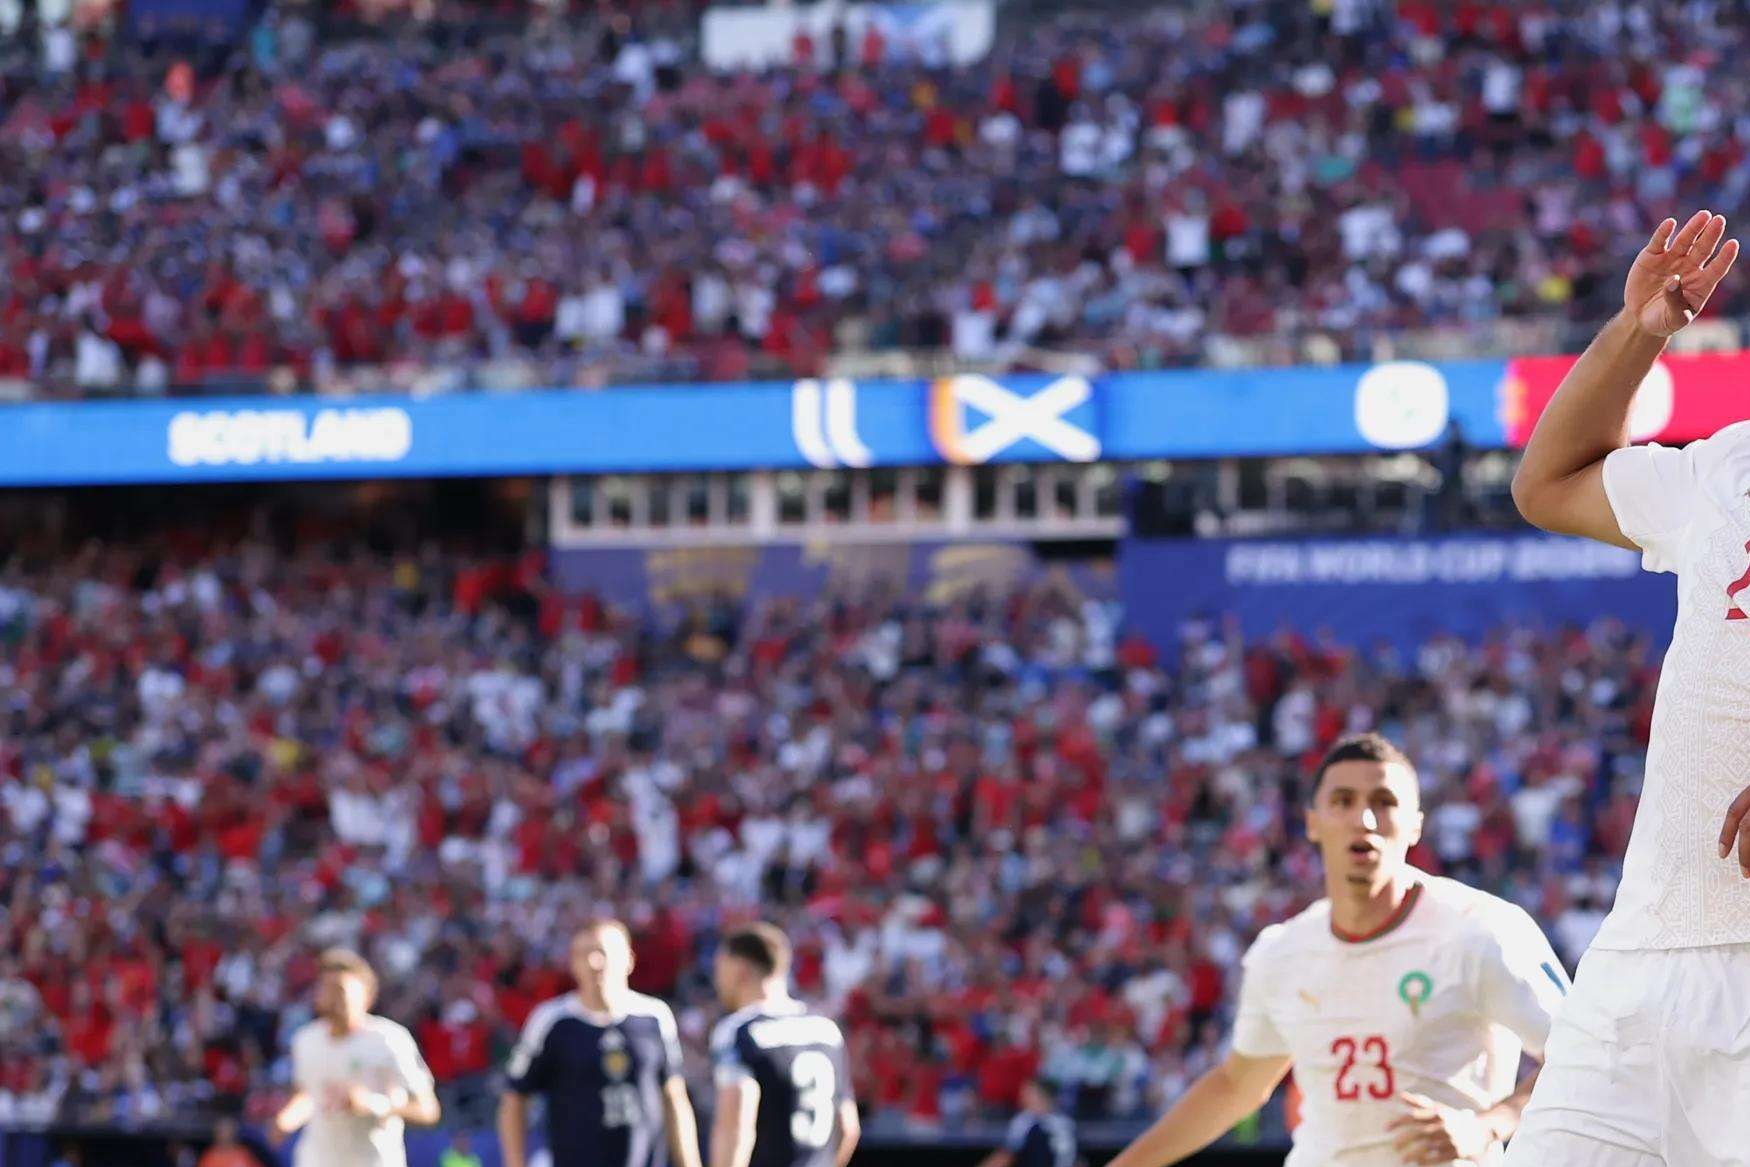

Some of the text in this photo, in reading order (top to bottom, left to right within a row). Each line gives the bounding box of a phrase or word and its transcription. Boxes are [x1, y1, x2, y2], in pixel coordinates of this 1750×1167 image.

[168, 408, 412, 466] SCOTLAND
[789, 1049, 836, 1148] 3
[1331, 1036, 1394, 1100] 23
